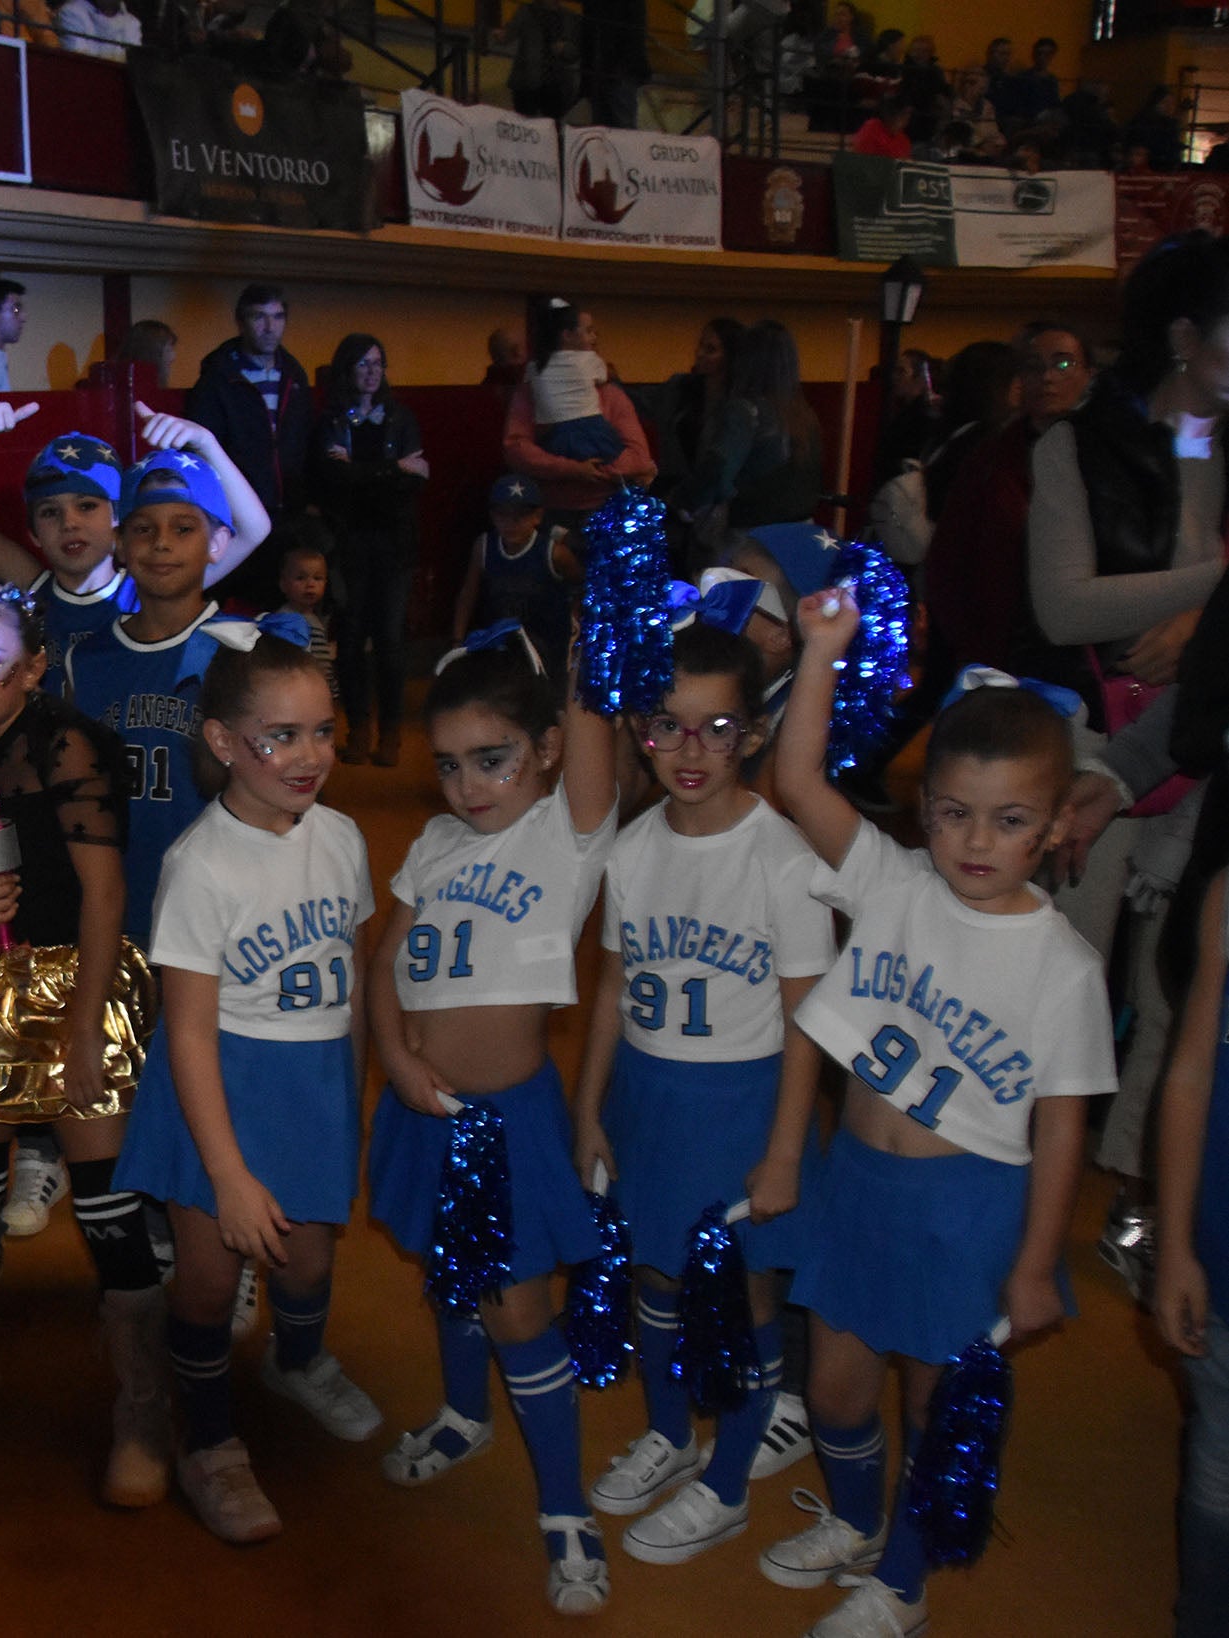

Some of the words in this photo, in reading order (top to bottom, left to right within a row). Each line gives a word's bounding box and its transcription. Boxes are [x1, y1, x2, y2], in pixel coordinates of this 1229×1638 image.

[170, 139, 196, 173] EL
[199, 143, 330, 186] VENTORRO
[649, 144, 699, 163] GRUPO
[408, 920, 473, 982] 91
[851, 947, 908, 1003] LOS
[277, 956, 348, 1012] 91
[629, 971, 713, 1037] 91
[851, 1024, 965, 1131] 91
